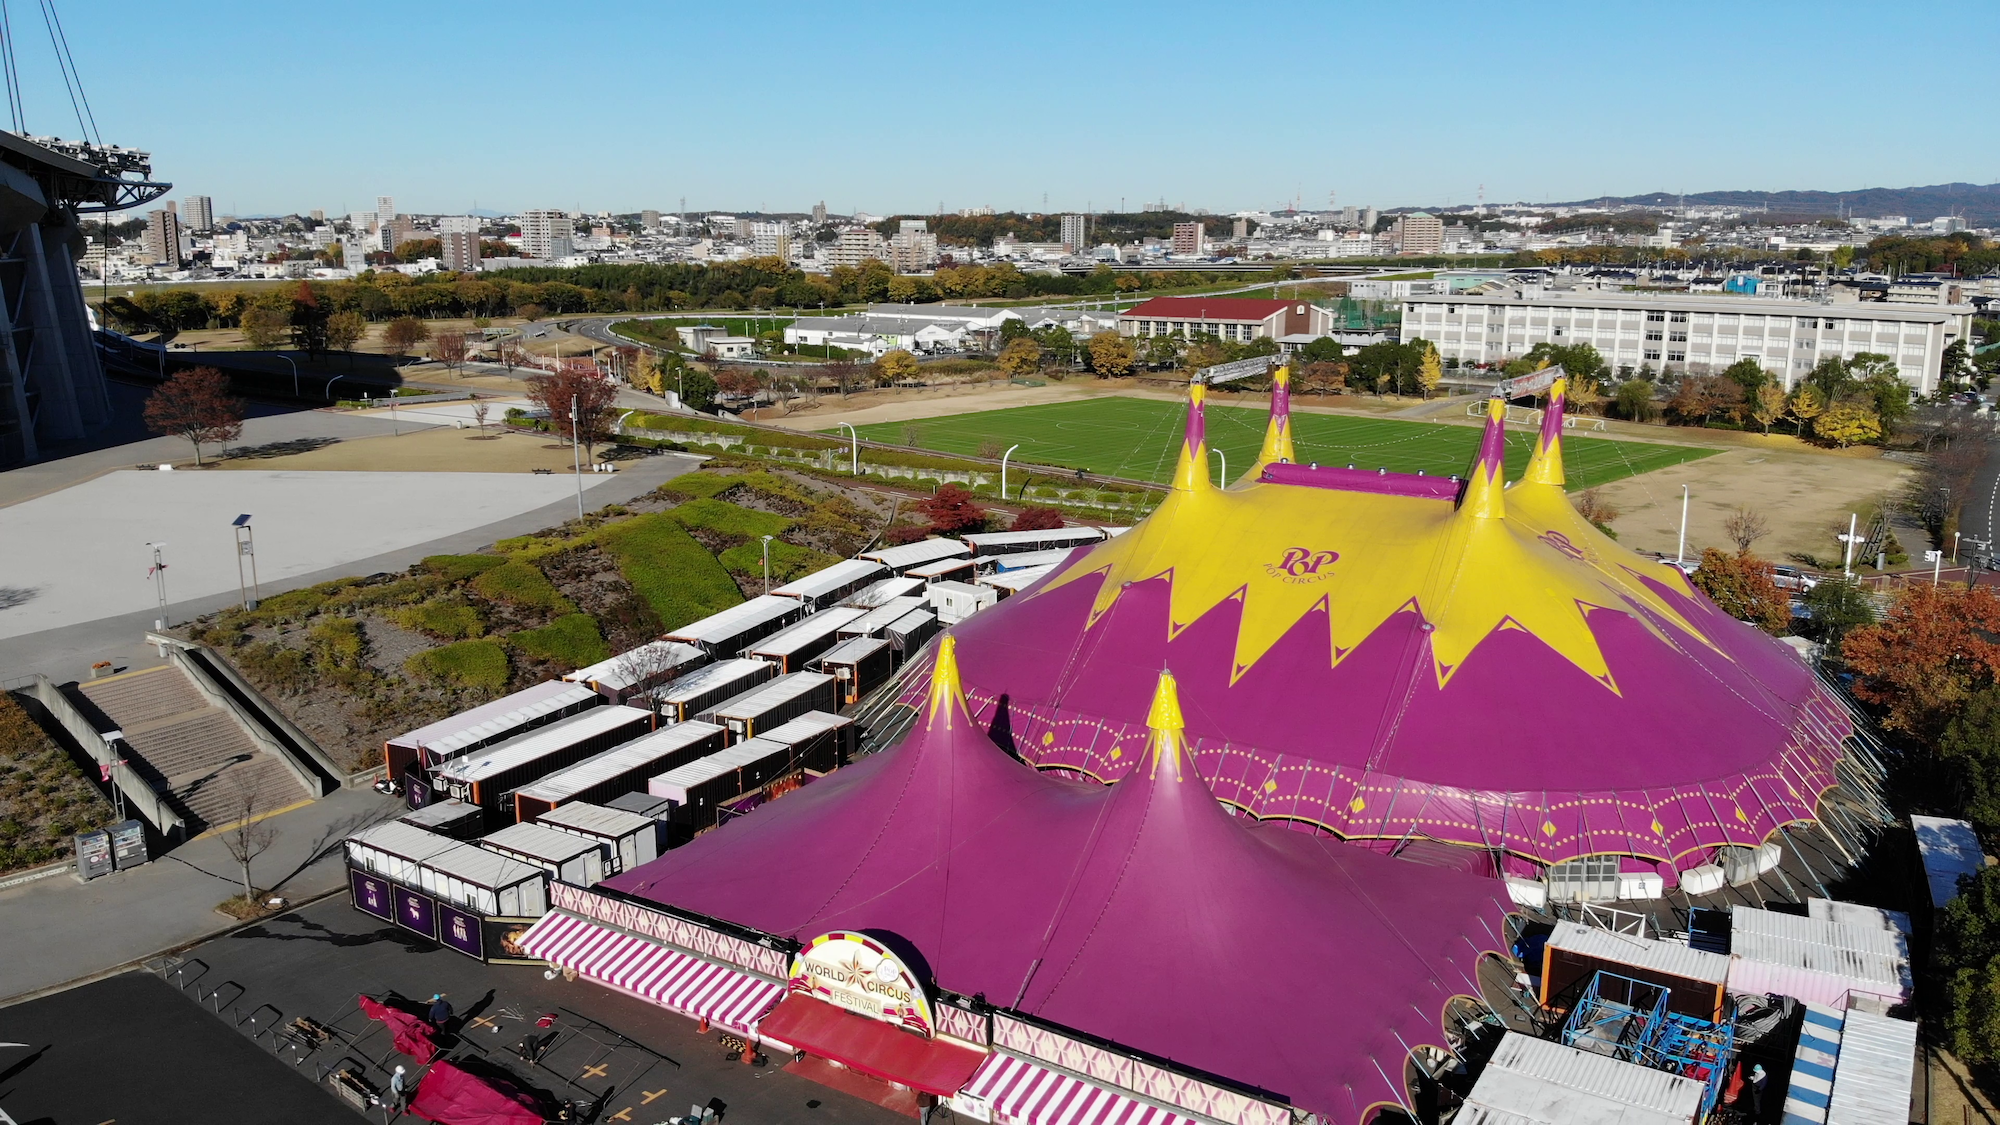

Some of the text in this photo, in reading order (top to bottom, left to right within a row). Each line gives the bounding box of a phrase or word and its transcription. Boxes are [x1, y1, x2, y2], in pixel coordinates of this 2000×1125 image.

[1263, 563, 1335, 584] POP CIRCUS
[1275, 547, 1340, 576] POP
[805, 961, 911, 1003] WORLD CIRCUS
[834, 990, 879, 1015] FESTIVAL
